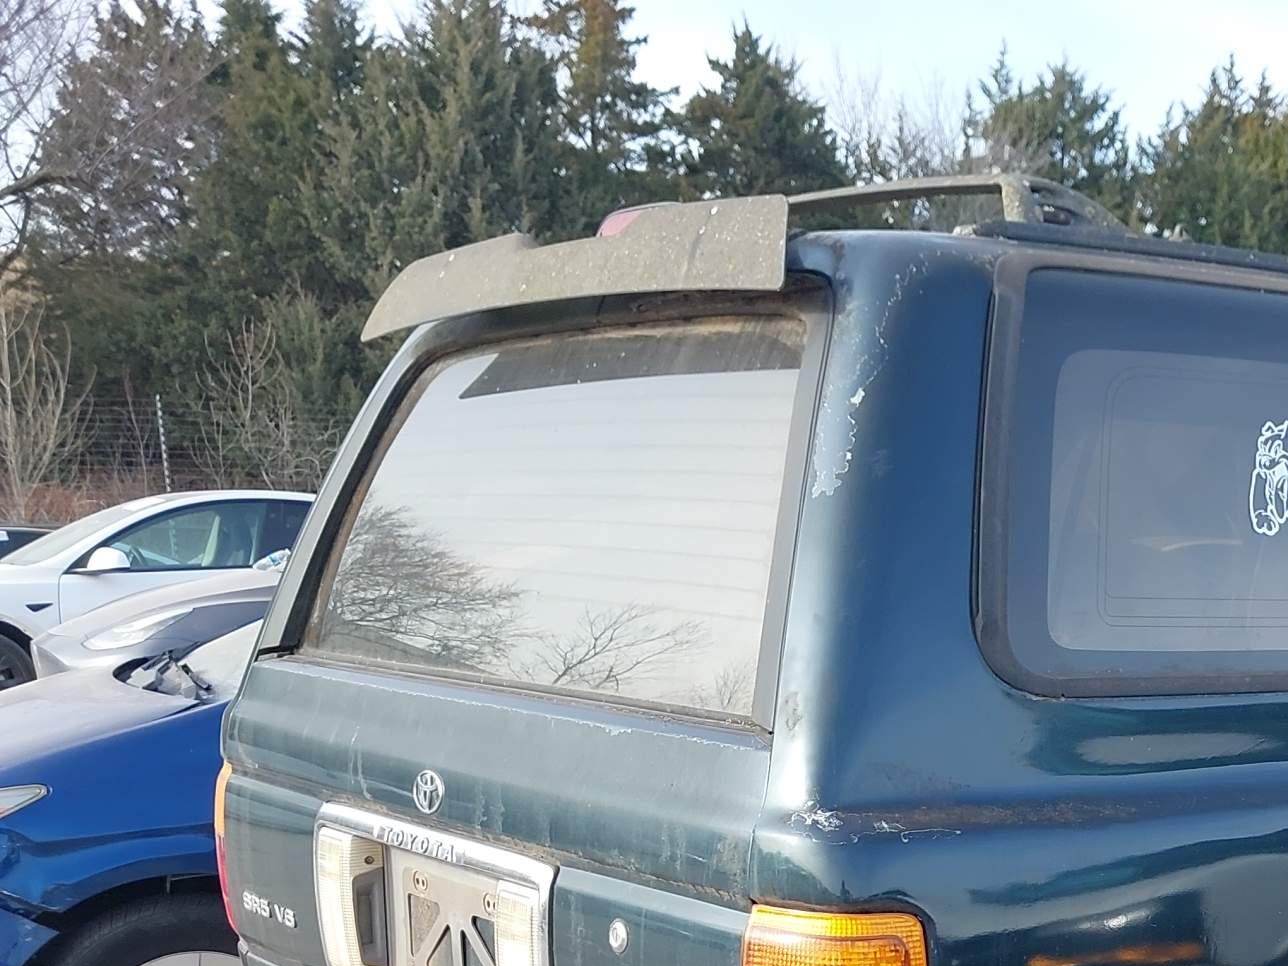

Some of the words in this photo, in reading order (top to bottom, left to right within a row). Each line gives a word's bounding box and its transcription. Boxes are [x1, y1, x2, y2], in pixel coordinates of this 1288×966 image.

[383, 826, 457, 863] TOYOTA
[242, 891, 272, 918] SR5
[274, 903, 297, 928] V6
